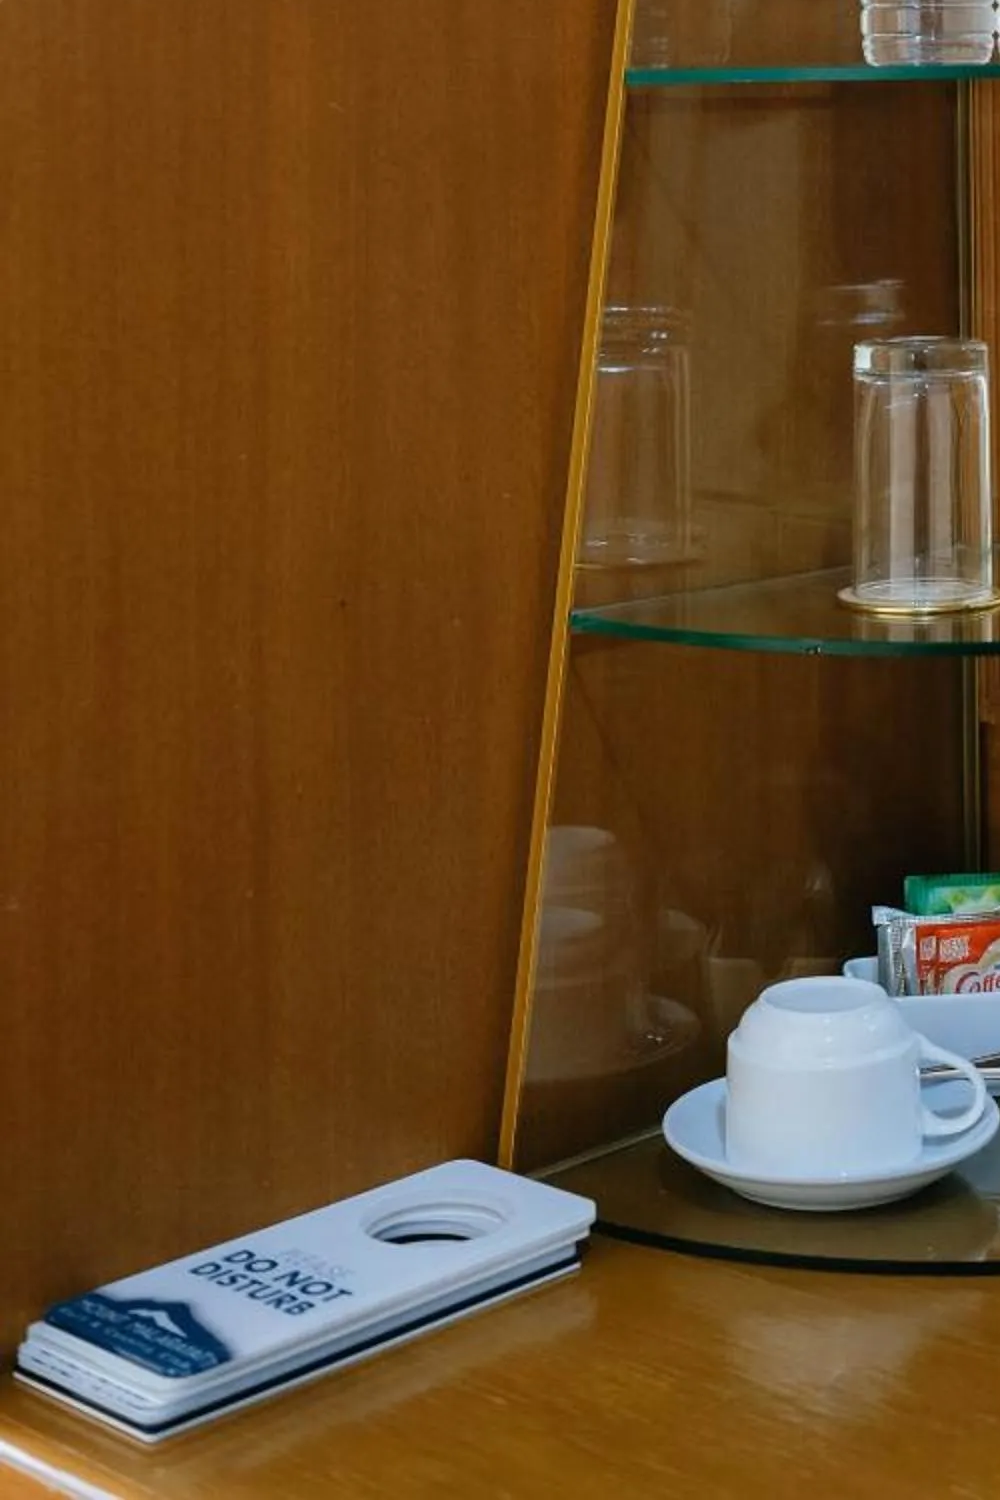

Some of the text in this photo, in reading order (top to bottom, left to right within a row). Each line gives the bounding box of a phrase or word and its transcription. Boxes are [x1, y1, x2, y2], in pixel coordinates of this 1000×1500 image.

[188, 1262, 316, 1316] DISTURB
[222, 1249, 353, 1303] DO NOT
